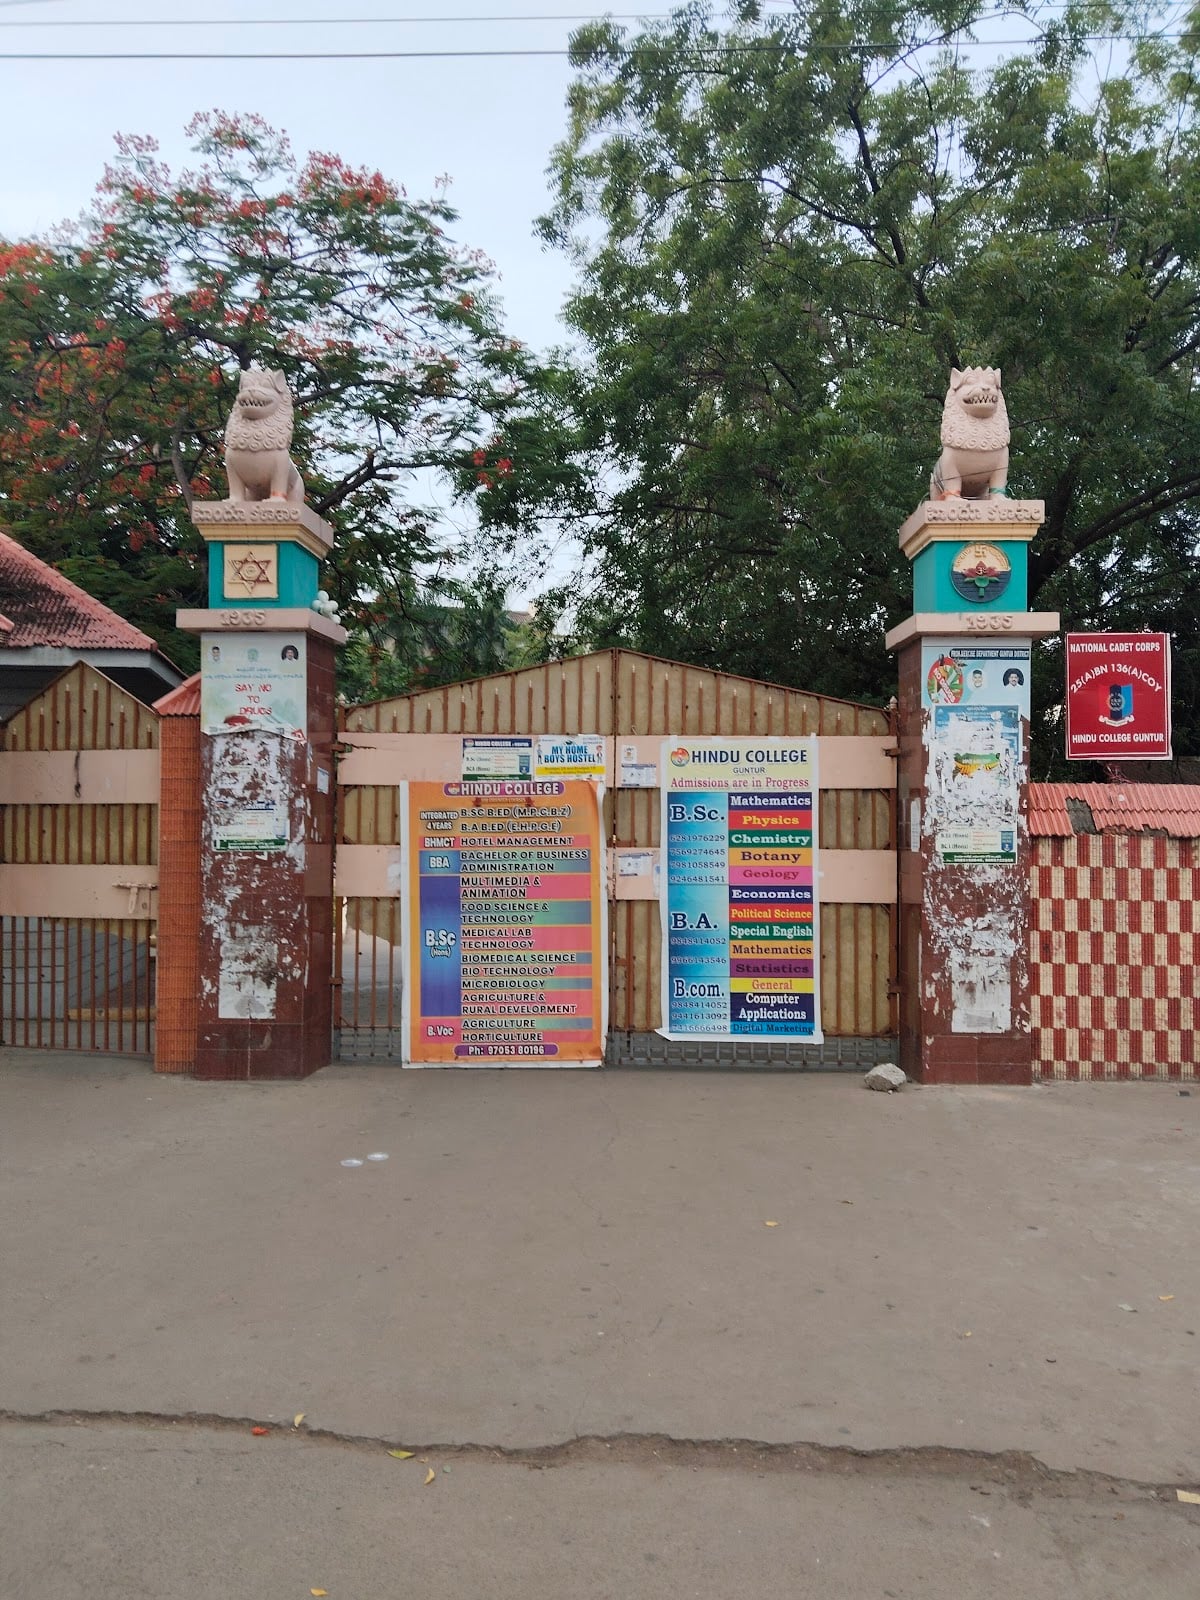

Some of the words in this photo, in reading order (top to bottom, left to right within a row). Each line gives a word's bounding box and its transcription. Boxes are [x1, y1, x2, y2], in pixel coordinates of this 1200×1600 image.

[220, 610, 266, 626] 1935
[966, 615, 1013, 630] 1935
[1070, 643, 1108, 653] NATIONAL
[1109, 643, 1134, 652] CADET
[1135, 642, 1161, 652] CORPS
[1070, 664, 1109, 694] 25(A)BN
[1111, 663, 1163, 692] 136(A)COY
[235, 684, 254, 692] SAY
[258, 684, 272, 692] NO
[247, 695, 260, 704] TO
[239, 707, 272, 715] DRUGS
[1072, 734, 1097, 743] HINDU
[1099, 733, 1131, 742] COLLEGE
[1133, 733, 1164, 742] GUNTUR
[552, 746, 564, 754] MY
[566, 745, 588, 754] HOME
[544, 755, 565, 763] BOYS
[567, 754, 596, 763] HOSTEL
[692, 751, 740, 763] HINDU
[746, 750, 807, 762] COLLEGE
[671, 778, 729, 788] Admissions
[752, 778, 762, 787] in
[766, 777, 809, 789] Progress
[461, 784, 501, 795] HINDU
[505, 782, 559, 795] COLLEGE
[731, 796, 811, 806] Mathematics
[420, 811, 459, 820] INTEGRATED
[461, 808, 485, 818] B.SC
[487, 808, 510, 817] B.ED
[671, 805, 725, 821] B.Sc.
[427, 822, 432, 830] 4
[432, 822, 452, 830] YEARS
[743, 816, 799, 827] Physics
[461, 823, 478, 832] B.A
[481, 823, 504, 832] B.ED
[424, 837, 455, 848] BHMCT
[461, 838, 495, 846] HOTEL
[497, 837, 574, 846] MANAGEMENT
[731, 834, 810, 845] Chemistry
[461, 851, 517, 860] BACHELOR
[520, 851, 534, 859] OF
[537, 850, 588, 859] BUSINESS
[741, 851, 801, 863] Botany
[429, 857, 449, 868] BBA
[461, 863, 554, 872] ADMINISTRATION
[743, 869, 799, 880] Geology
[461, 877, 530, 886] MULTIMEDIA
[533, 877, 541, 885] &
[461, 889, 526, 898] ANIMATION
[732, 890, 811, 899] Economics
[461, 903, 491, 911] FOOD
[494, 903, 539, 911] SCIENCE
[542, 903, 549, 911] &
[731, 909, 771, 918] Political
[774, 909, 812, 918] Science
[461, 914, 534, 923] TECHNOLOGY
[672, 913, 718, 929] B.A.
[462, 929, 510, 937] MEDICAL
[512, 929, 532, 937] LAB
[731, 926, 769, 938] Special
[773, 926, 813, 939] English
[425, 930, 456, 946] B.Sc
[462, 940, 535, 949] TECHNOLOGY
[733, 945, 812, 955] Mathematics
[462, 954, 528, 963] BIOMEDICAL
[530, 954, 576, 962] SCIENCE
[462, 967, 480, 975] BIO
[482, 967, 555, 975] TECHNOLOGY
[736, 964, 809, 973] Statistics
[462, 980, 545, 989] MICROBIOLOGY
[674, 980, 725, 997] B.com.
[752, 980, 793, 990] General
[462, 994, 536, 1002] AGRICULTURE
[538, 994, 545, 1002] &
[745, 994, 799, 1005] Computer
[462, 1005, 496, 1014] RURAL
[499, 1005, 577, 1014] DEVELOPMENT
[738, 1009, 806, 1021] Applications
[462, 1019, 536, 1028] AGRICULTURE
[733, 1024, 763, 1034] Digital
[766, 1025, 813, 1035] Marketing
[462, 1033, 543, 1042] HORTICULTURE
[468, 1046, 484, 1055] Ph:
[488, 1046, 515, 1055] 97053
[518, 1046, 544, 1055] 80196
